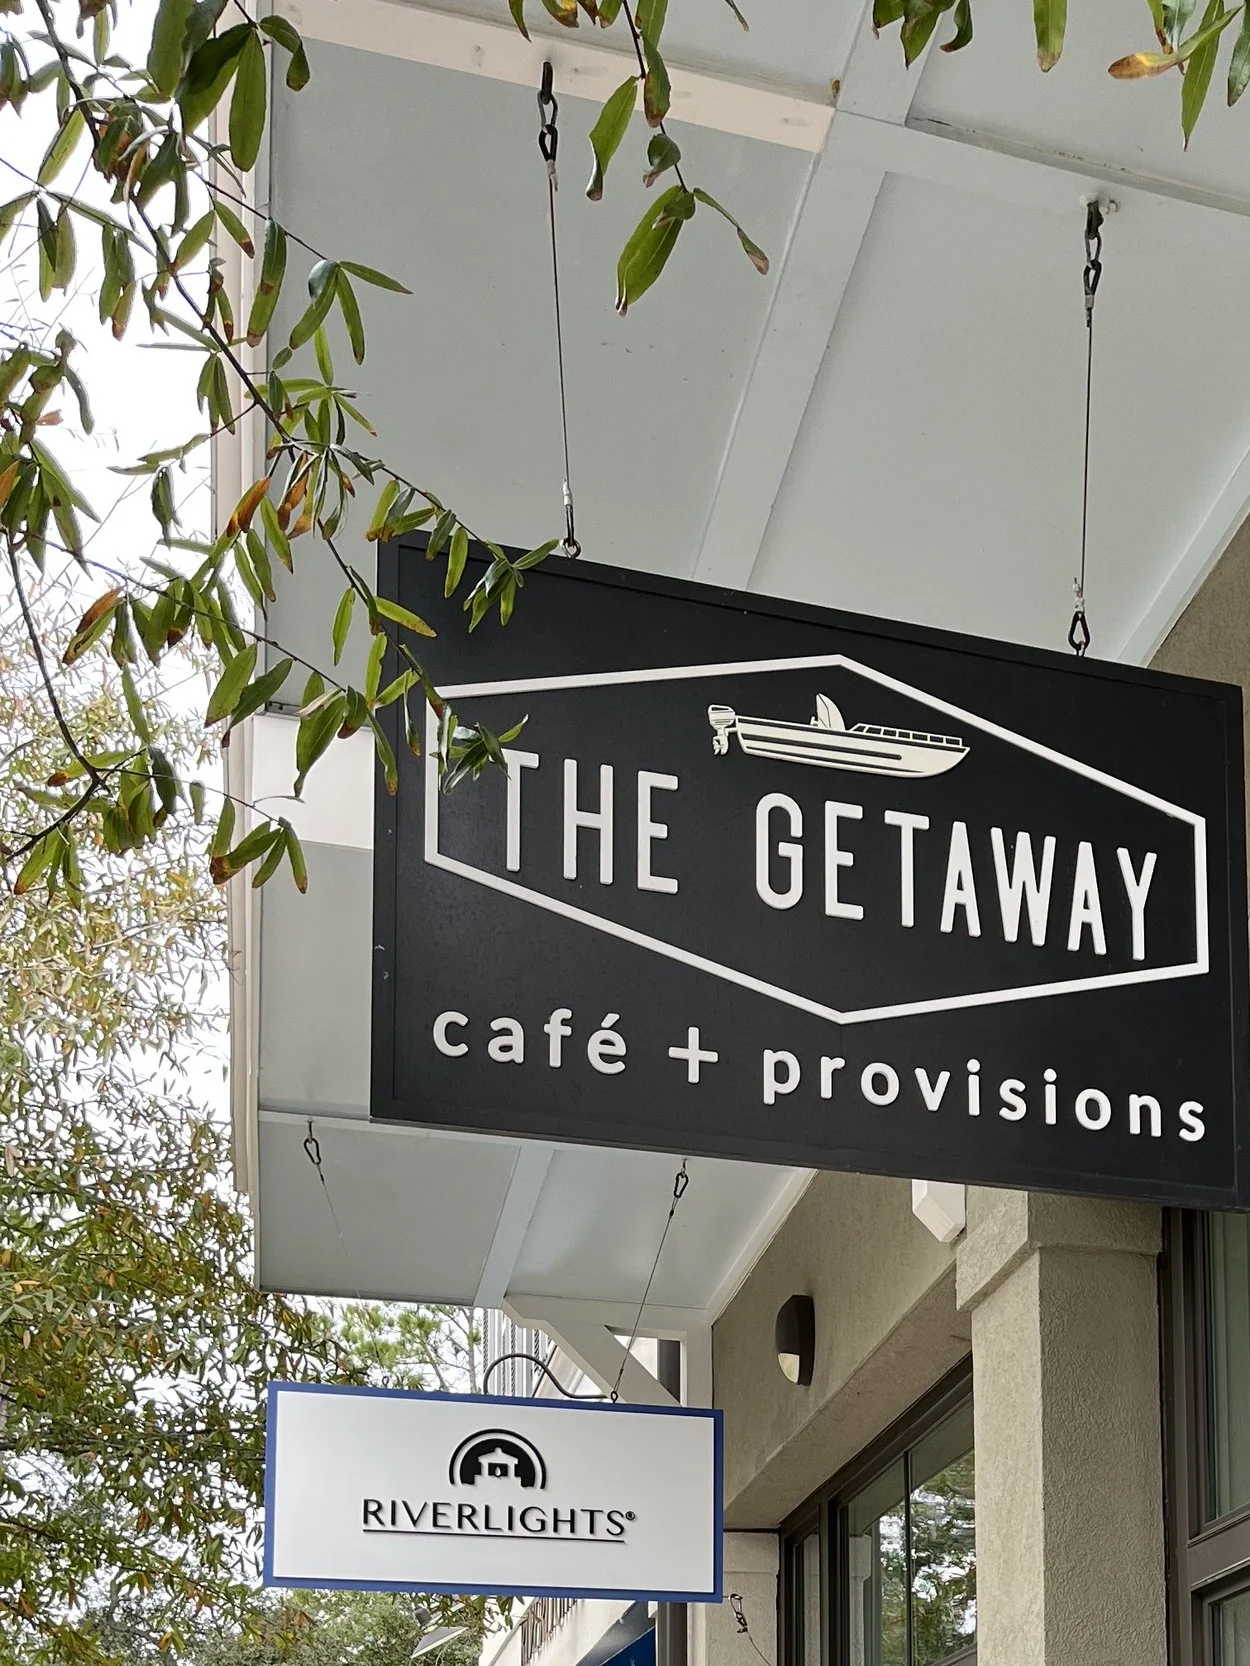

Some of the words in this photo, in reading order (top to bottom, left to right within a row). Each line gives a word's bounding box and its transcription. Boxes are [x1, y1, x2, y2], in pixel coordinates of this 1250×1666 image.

[501, 751, 680, 894] THE
[754, 792, 1158, 961] GETAWAY
[432, 1008, 628, 1077] café
[668, 1027, 719, 1084] +
[763, 1047, 1206, 1143] provisions
